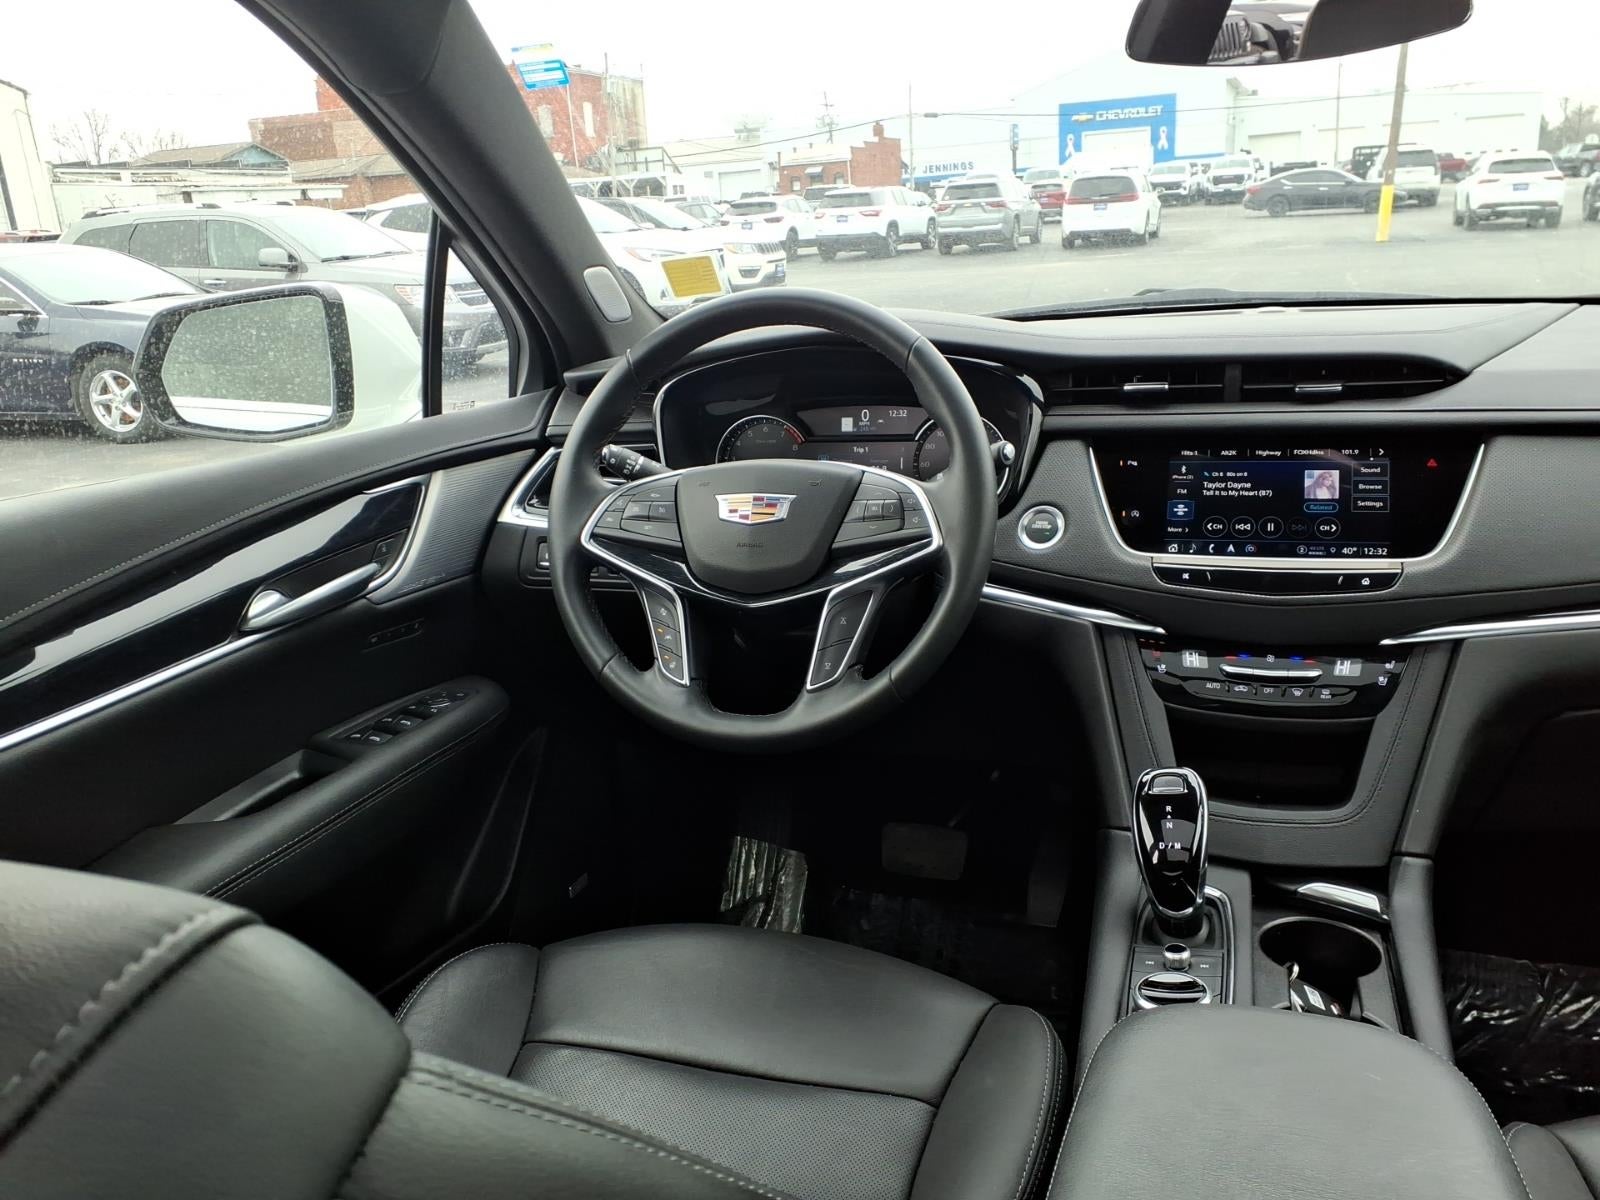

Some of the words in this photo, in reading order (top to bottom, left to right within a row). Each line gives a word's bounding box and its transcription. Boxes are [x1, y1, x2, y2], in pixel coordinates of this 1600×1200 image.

[1096, 105, 1163, 120] CHEVROLET
[923, 162, 974, 174] JENNINGS
[861, 409, 870, 421] 0
[853, 446, 864, 454] Trip
[1363, 547, 1388, 555] 12:32
[1186, 651, 1200, 667] HI
[1336, 660, 1351, 675] HI
[1166, 821, 1173, 829] N
